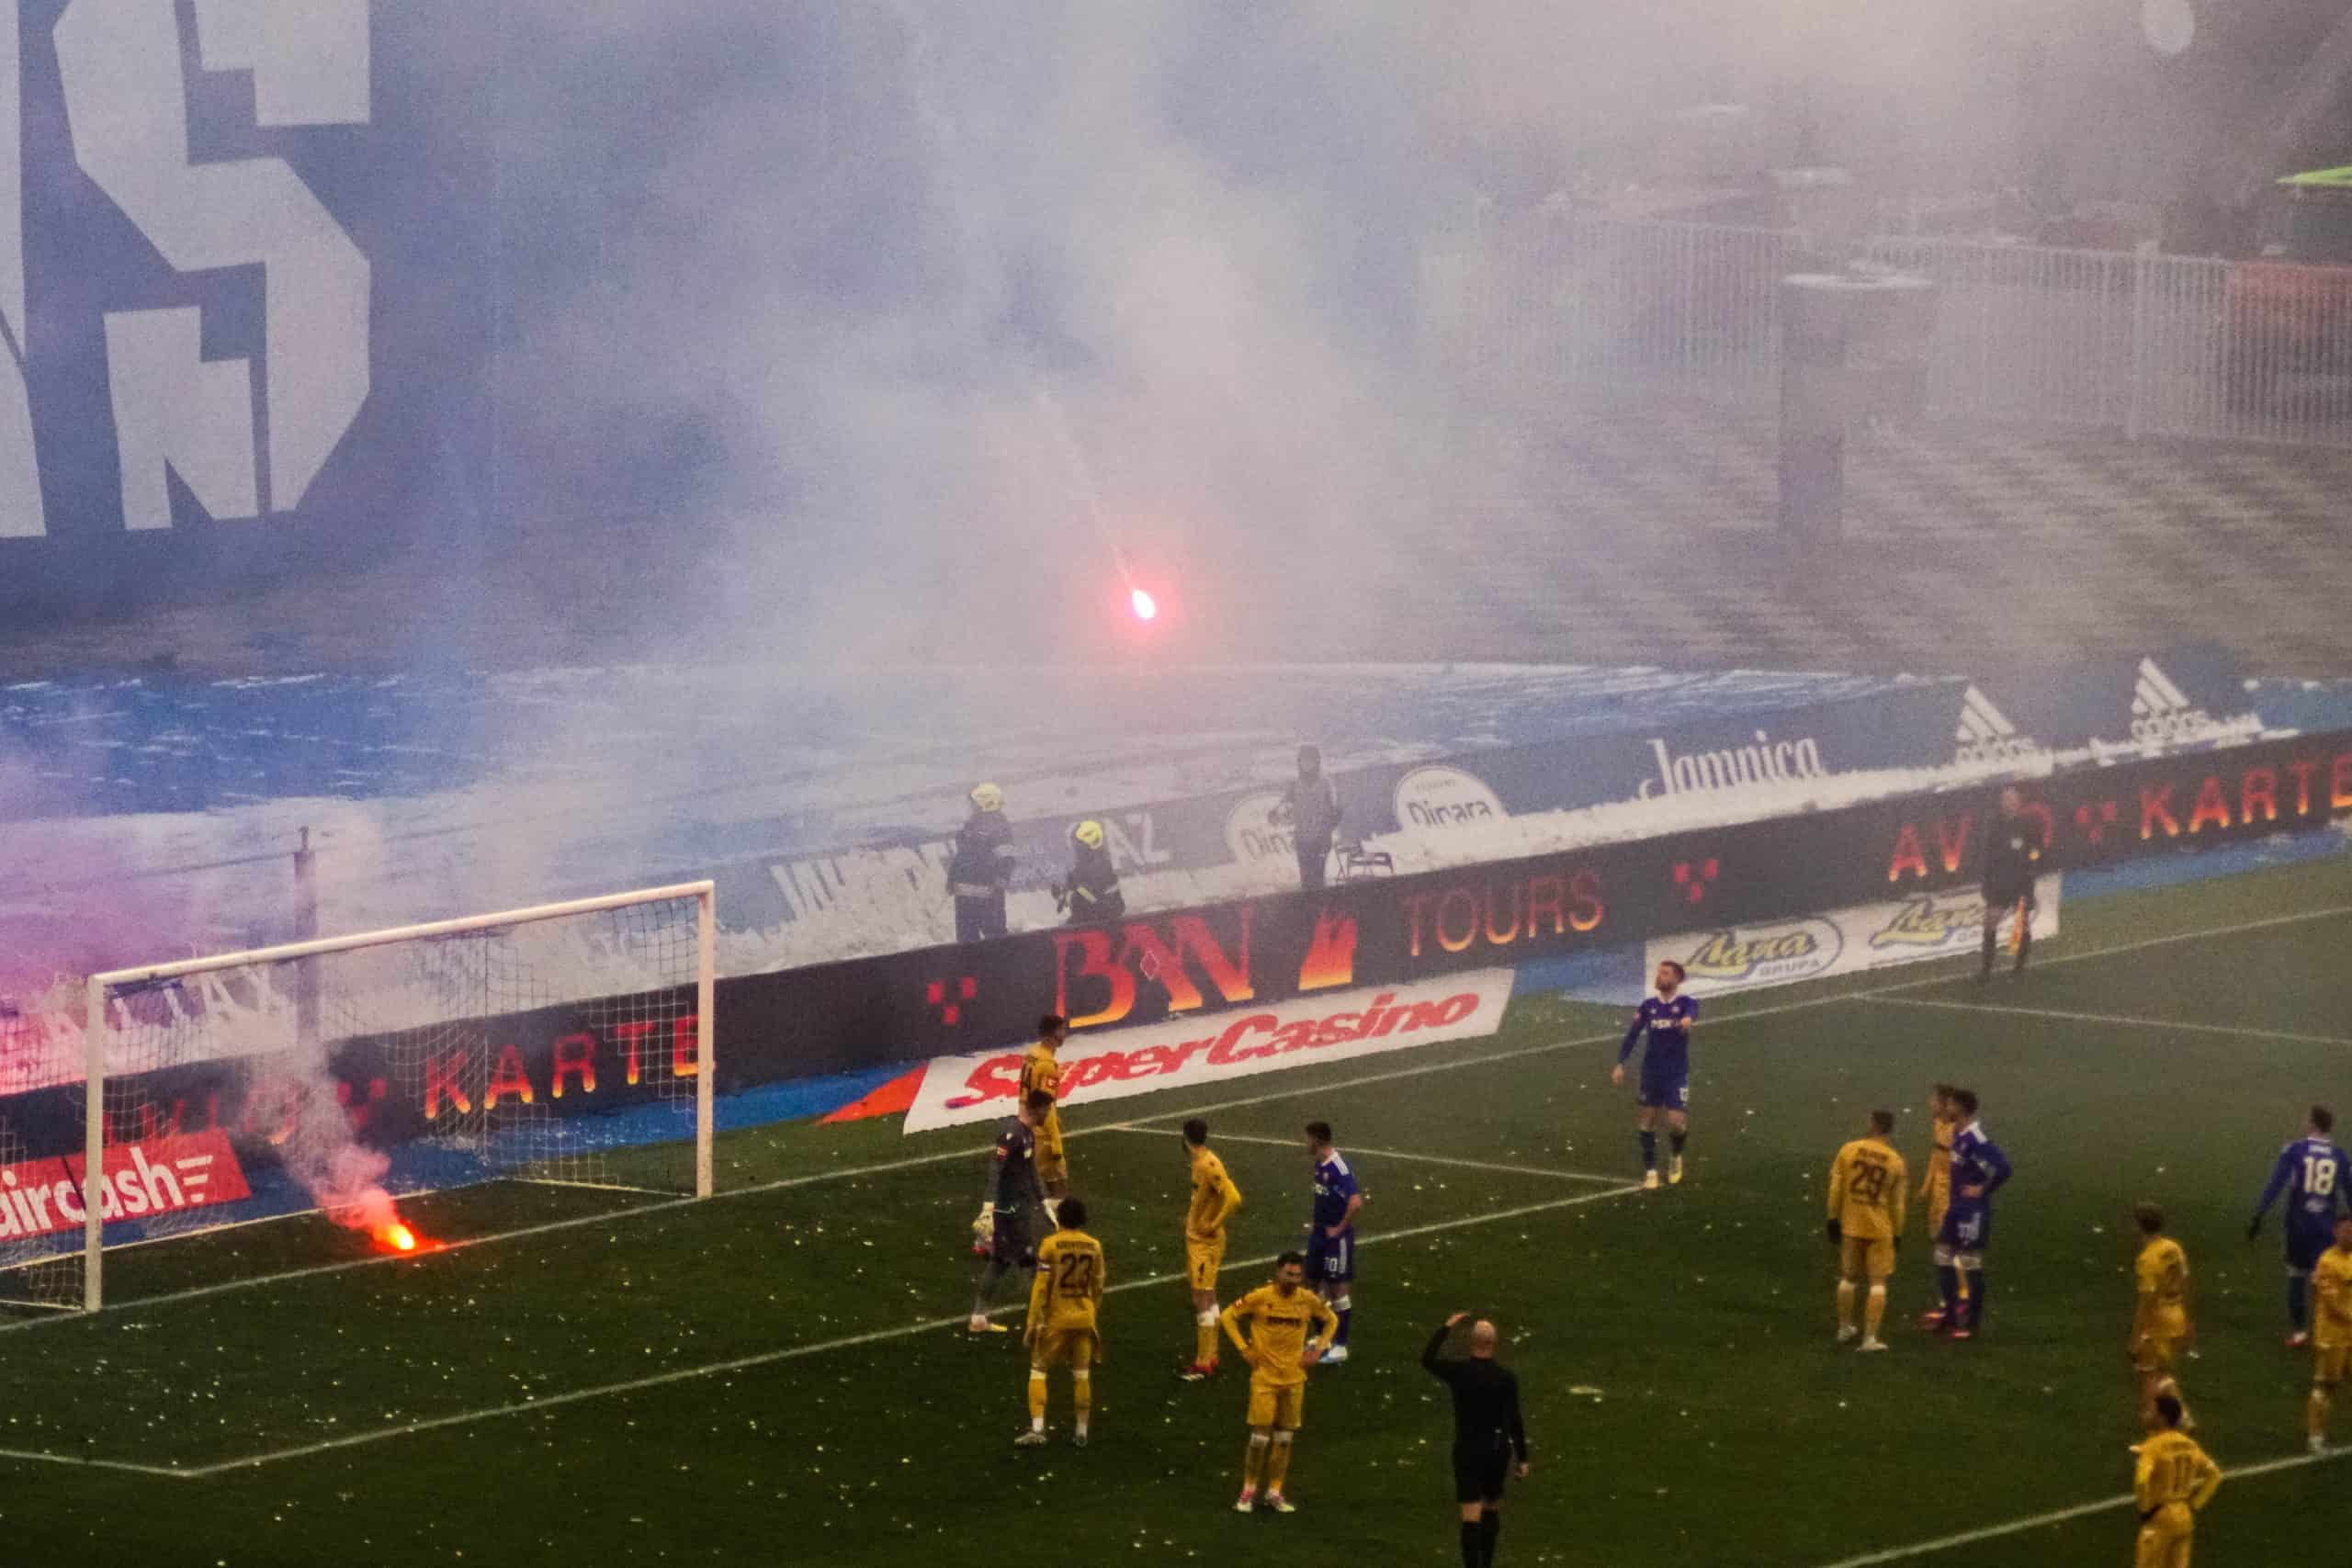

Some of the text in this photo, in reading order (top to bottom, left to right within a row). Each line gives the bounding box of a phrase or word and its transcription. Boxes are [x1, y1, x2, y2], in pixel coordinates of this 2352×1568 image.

[1639, 730, 1825, 800] Jamnica
[2138, 759, 2352, 840] KARTE
[1406, 798, 1494, 828] Dinara
[1054, 869, 1604, 1029] BAN TOURS
[424, 1013, 717, 1121] KARTE
[944, 990, 1480, 1109] SperCasino
[2303, 1156, 2337, 1195] 18
[1059, 1253, 1094, 1292] 23
